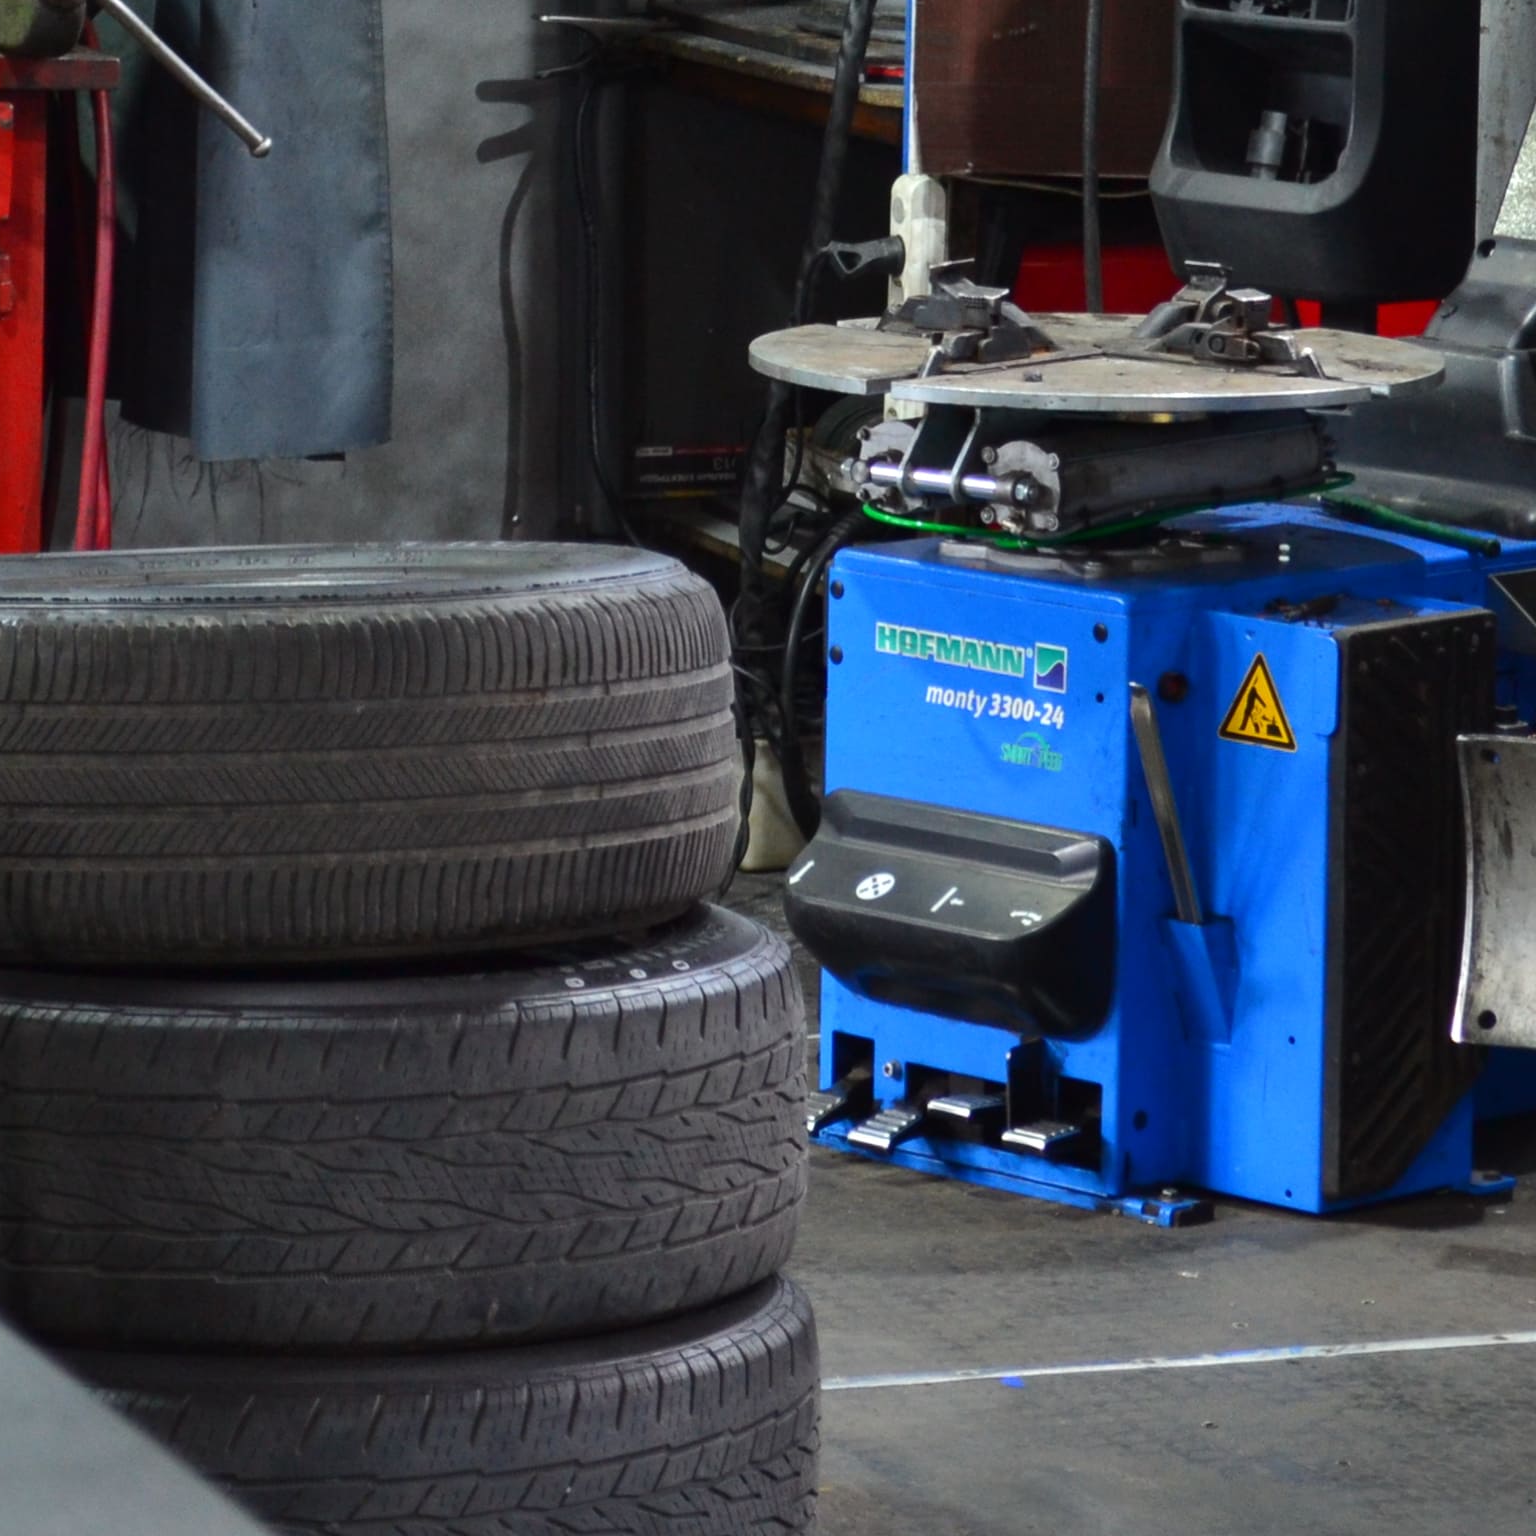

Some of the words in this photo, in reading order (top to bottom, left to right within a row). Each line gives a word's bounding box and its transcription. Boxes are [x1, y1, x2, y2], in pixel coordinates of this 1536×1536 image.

[875, 622, 1026, 678] HOFMANN
[925, 685, 988, 719] monty
[988, 692, 1065, 730] 3300-24
